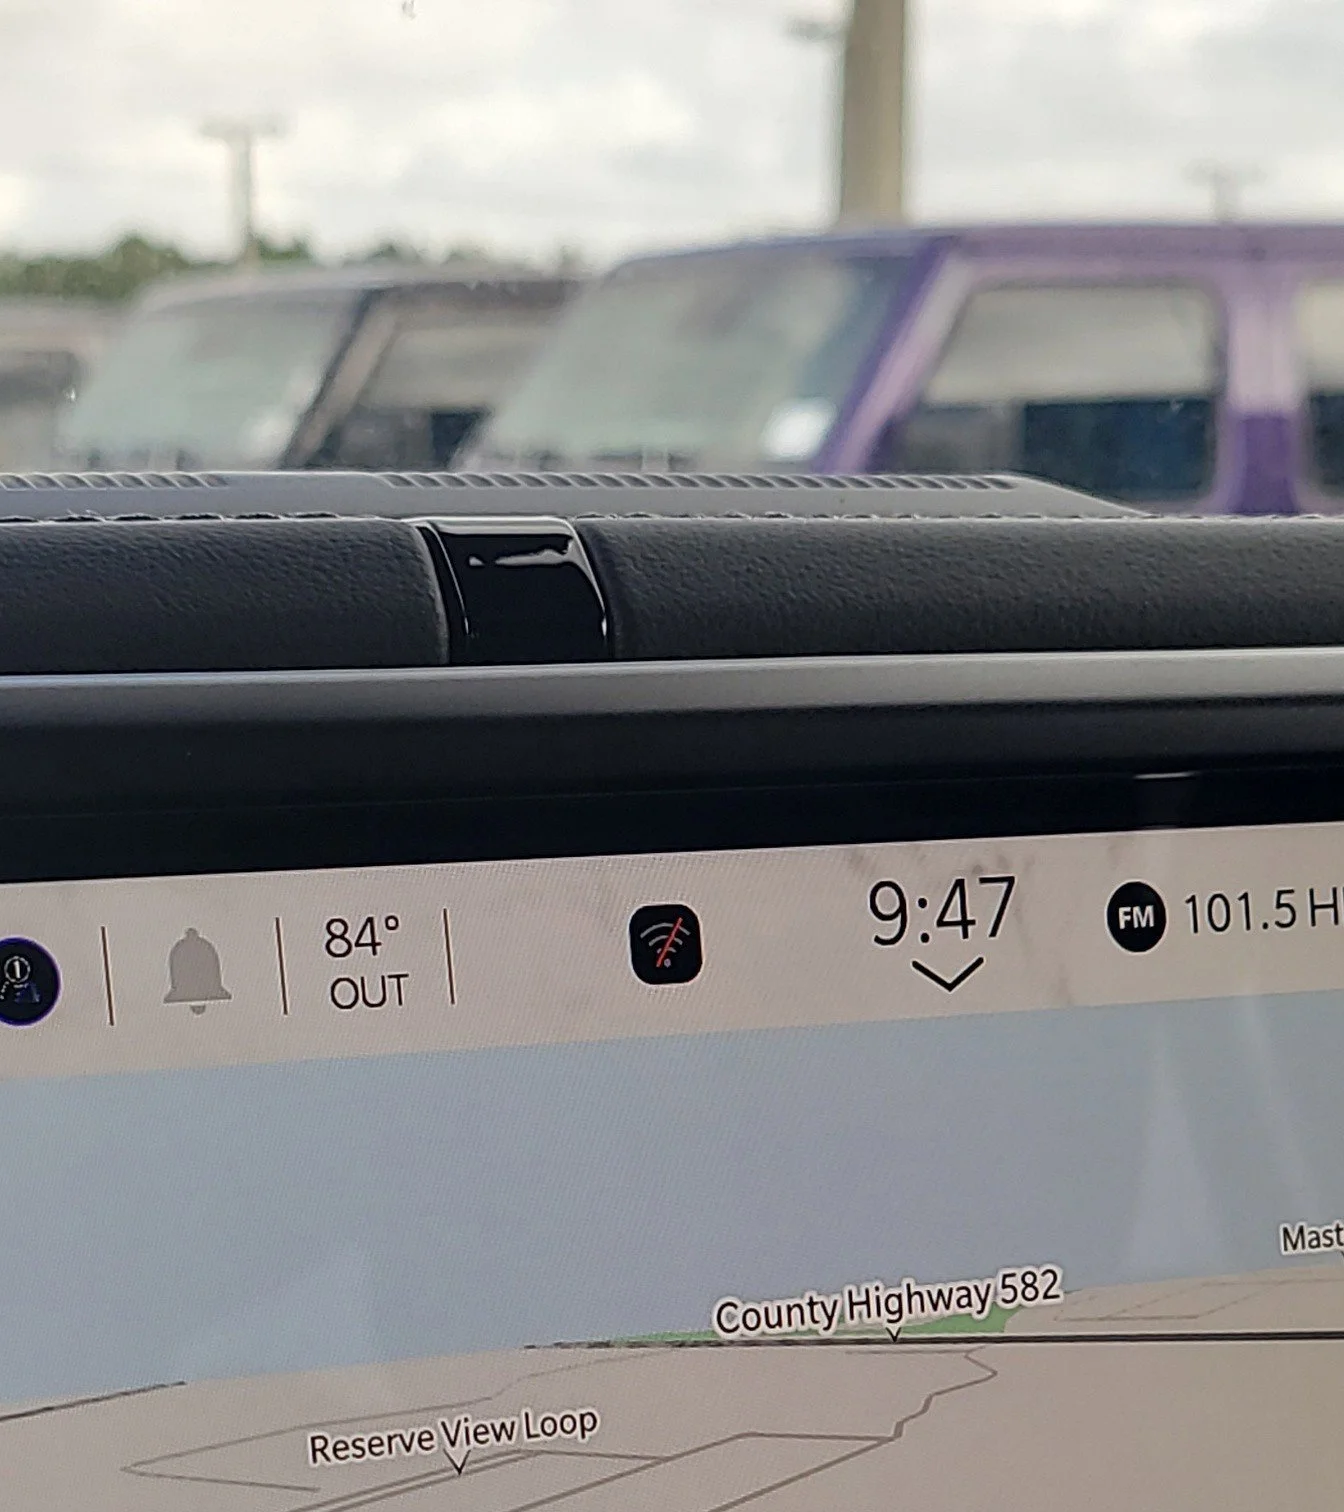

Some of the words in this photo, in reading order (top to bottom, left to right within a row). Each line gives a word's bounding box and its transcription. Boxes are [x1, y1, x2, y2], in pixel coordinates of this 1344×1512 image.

[867, 874, 1018, 948] 9:47
[1117, 904, 1155, 930] FM
[1185, 888, 1297, 934] 101.5
[329, 973, 409, 1011] OUT
[716, 1296, 838, 1334] County
[848, 1281, 991, 1323] Highway
[1001, 1269, 1060, 1304] 582
[310, 1428, 435, 1464] Reserve
[441, 1416, 516, 1447] View
[524, 1411, 598, 1439] Loop
